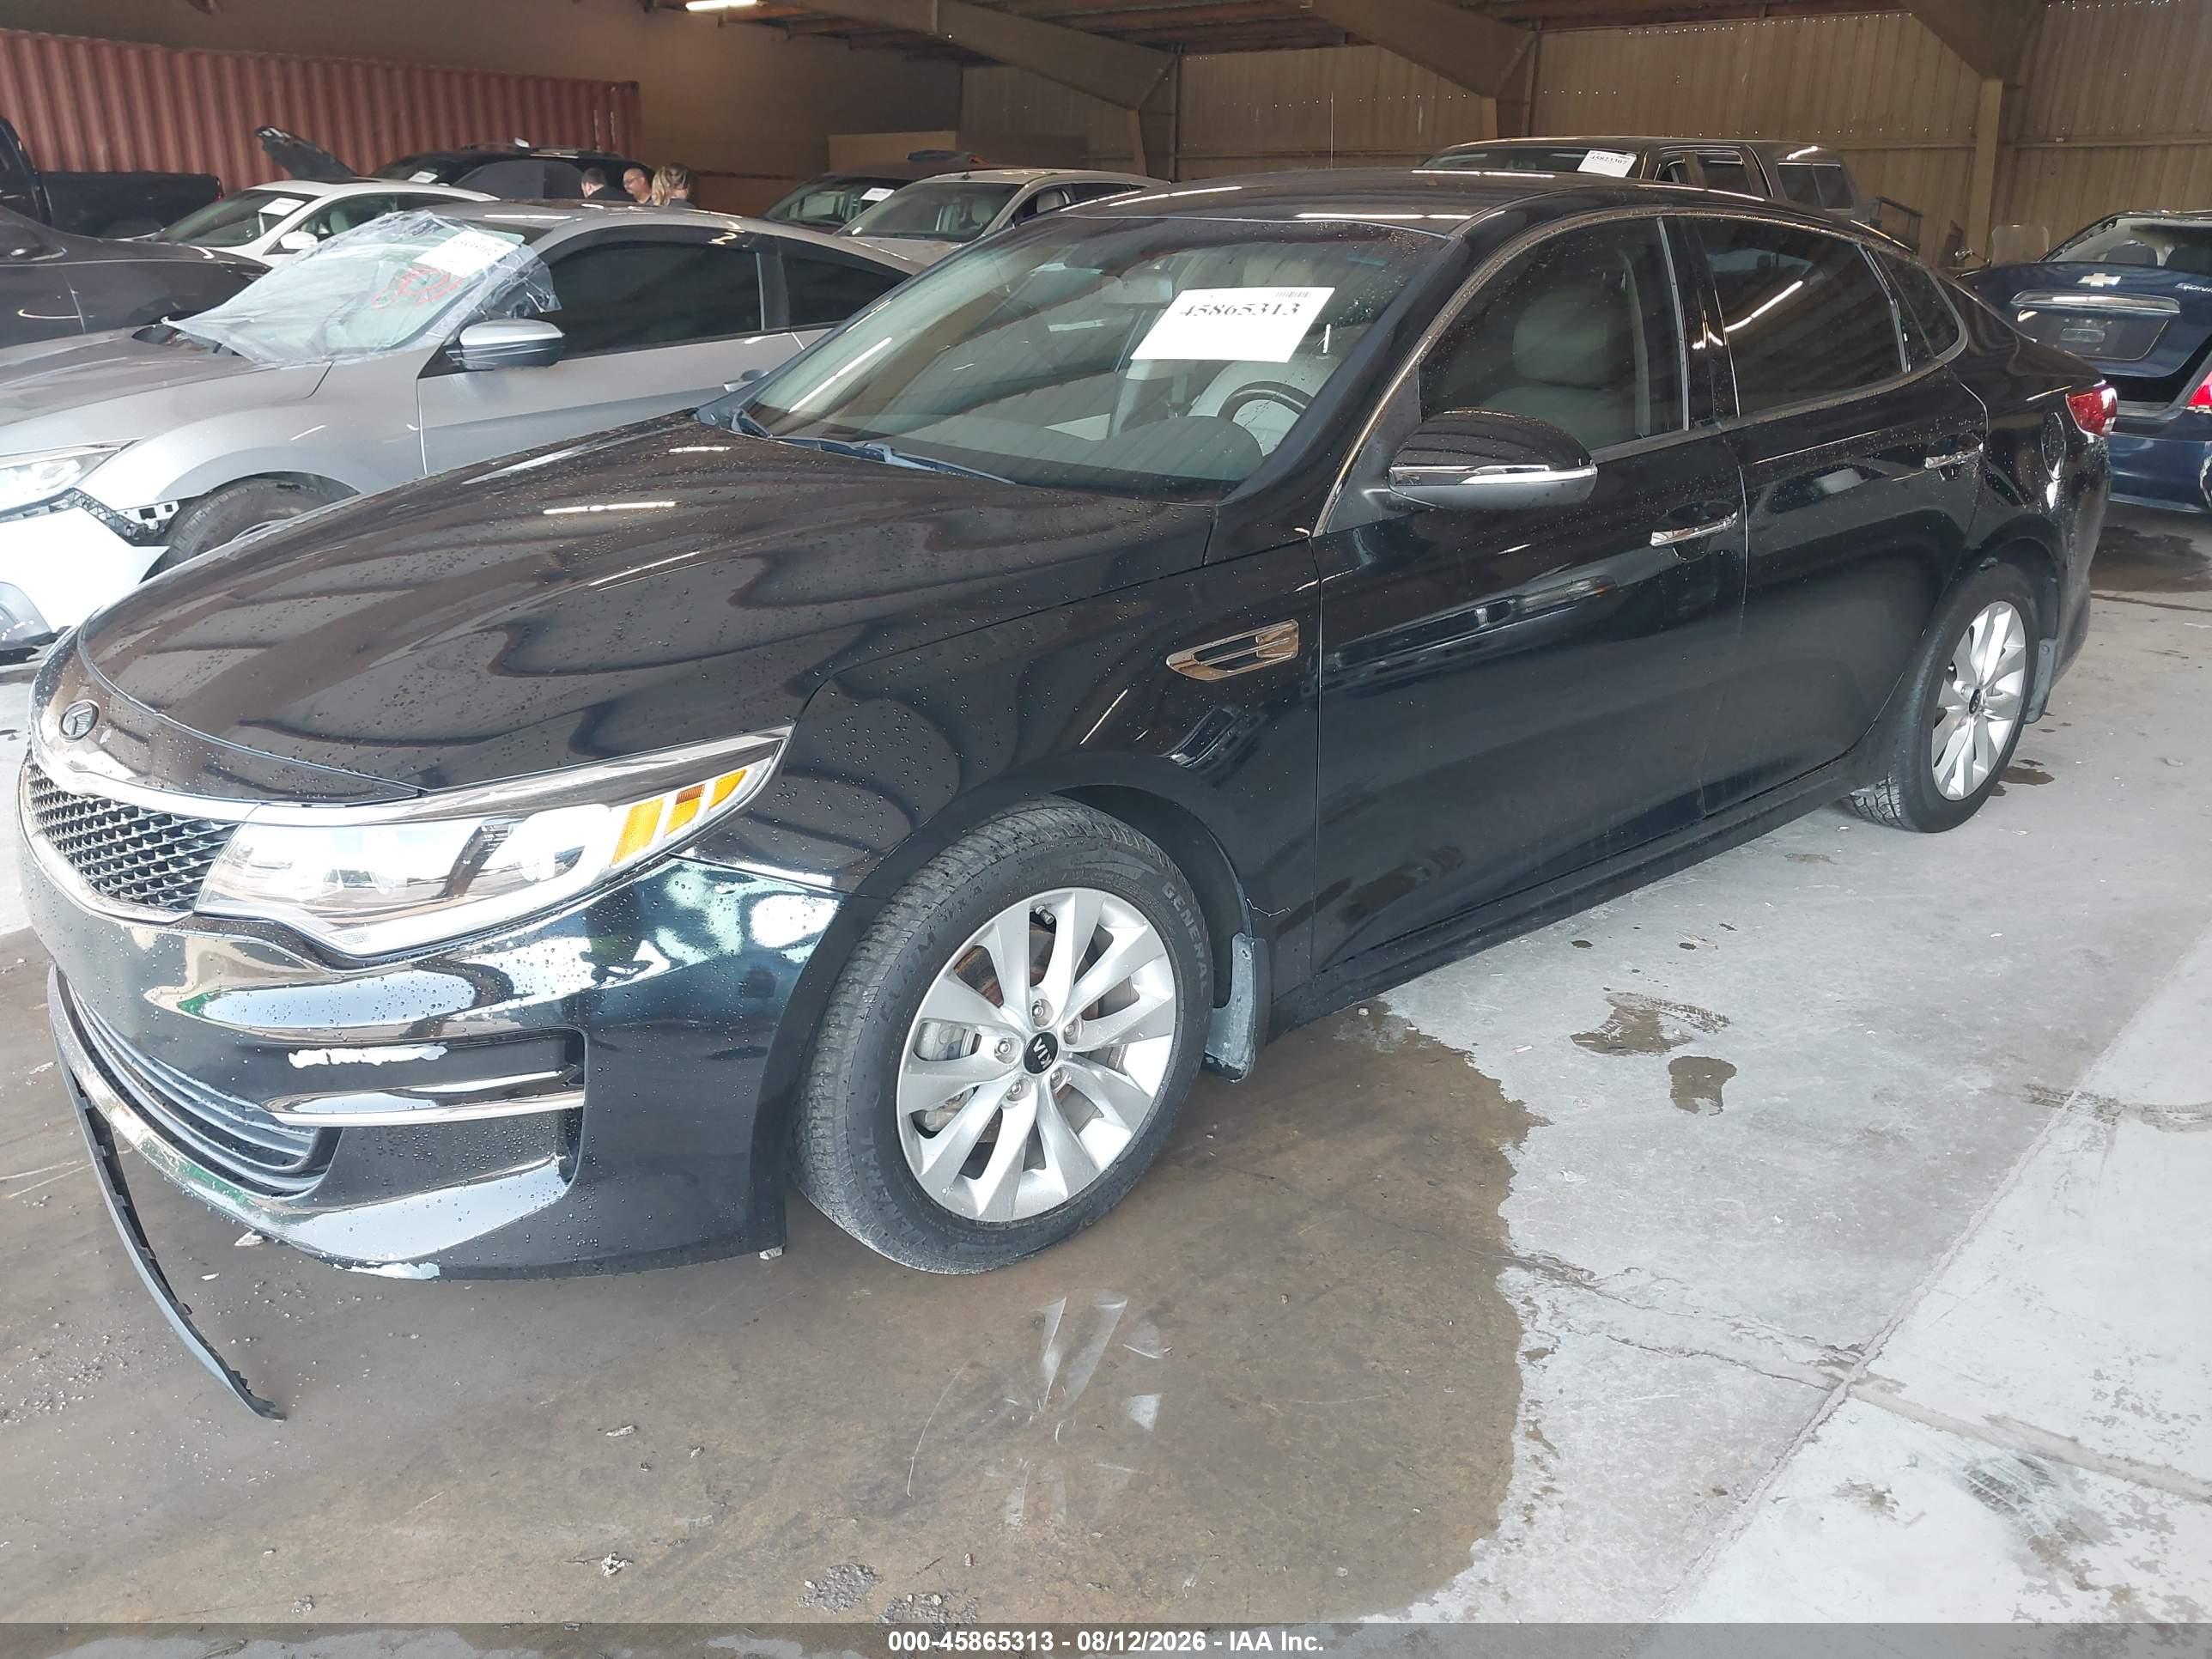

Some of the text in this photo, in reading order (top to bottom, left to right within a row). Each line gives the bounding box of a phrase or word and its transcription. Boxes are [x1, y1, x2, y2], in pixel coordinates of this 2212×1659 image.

[2174, 283, 2212, 293] SONI
[1180, 302, 1301, 317] 45865313
[1161, 880, 1209, 998] GENERAL
[1032, 1036, 1054, 1070] KIA
